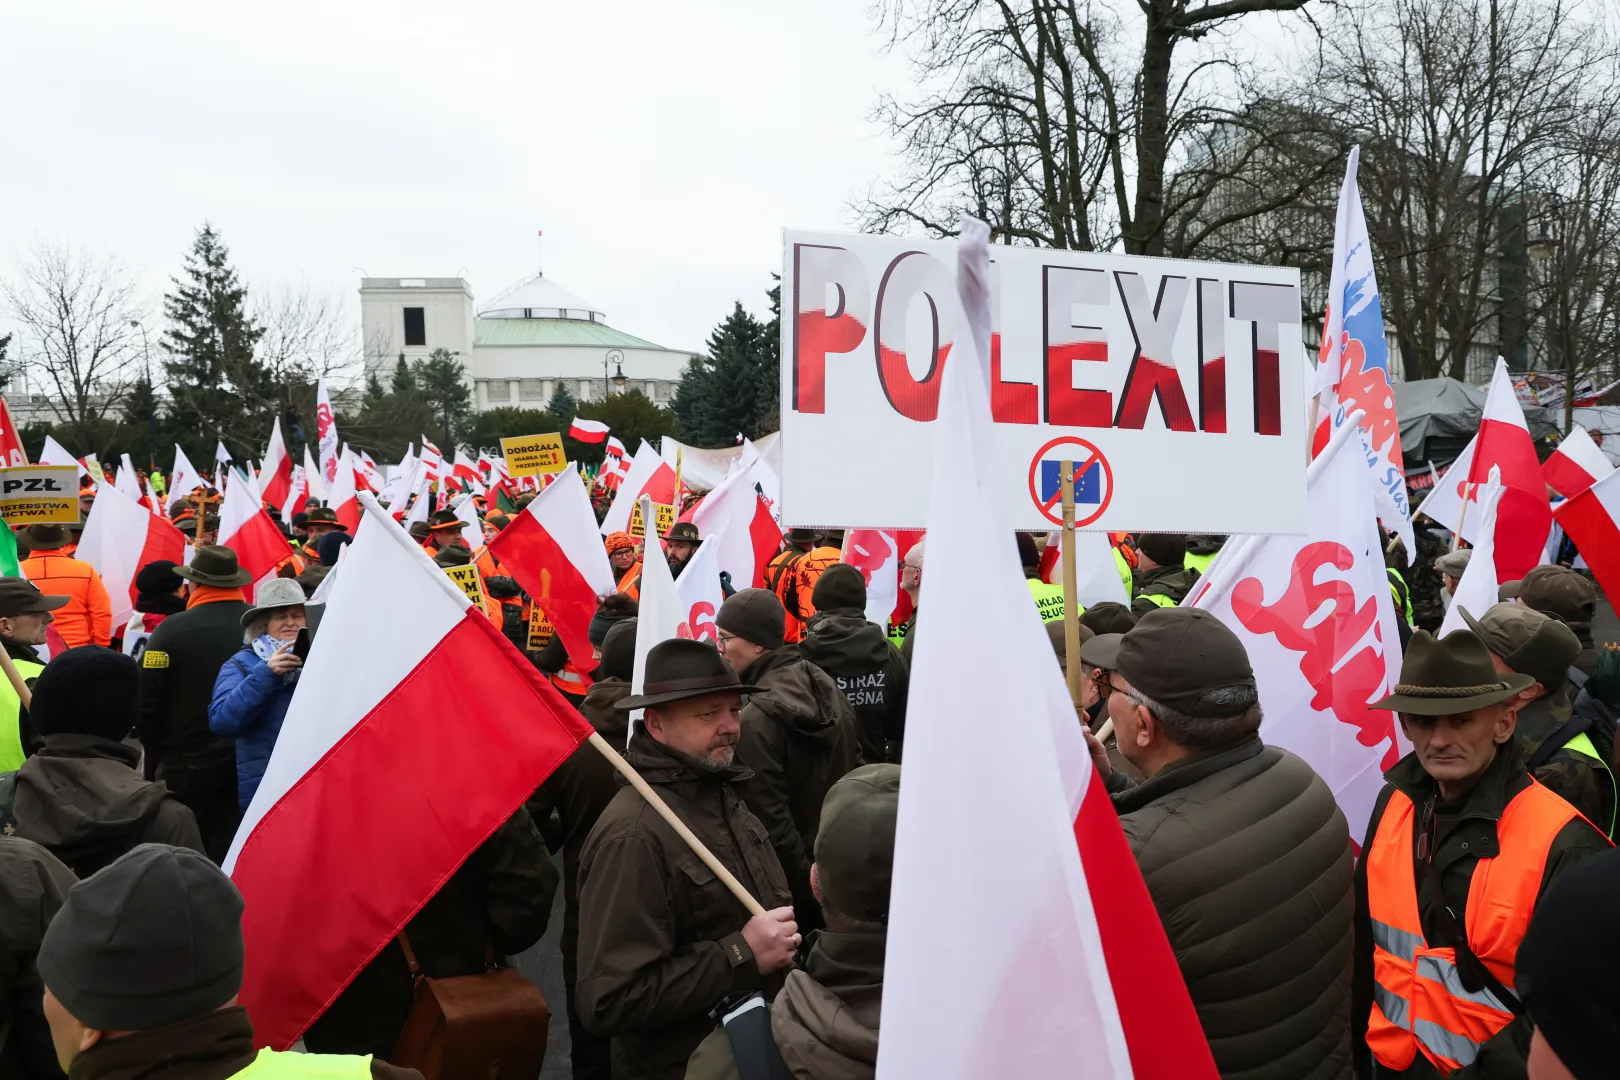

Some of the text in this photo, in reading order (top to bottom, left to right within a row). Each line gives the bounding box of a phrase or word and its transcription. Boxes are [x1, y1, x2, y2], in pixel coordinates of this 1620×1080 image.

[792, 243, 1300, 436] POLEXIT
[506, 443, 560, 455] DOROŻAŁA
[3, 478, 62, 494] PZŁ
[837, 671, 885, 690] STRAŻ
[847, 689, 884, 705] EŚNA
